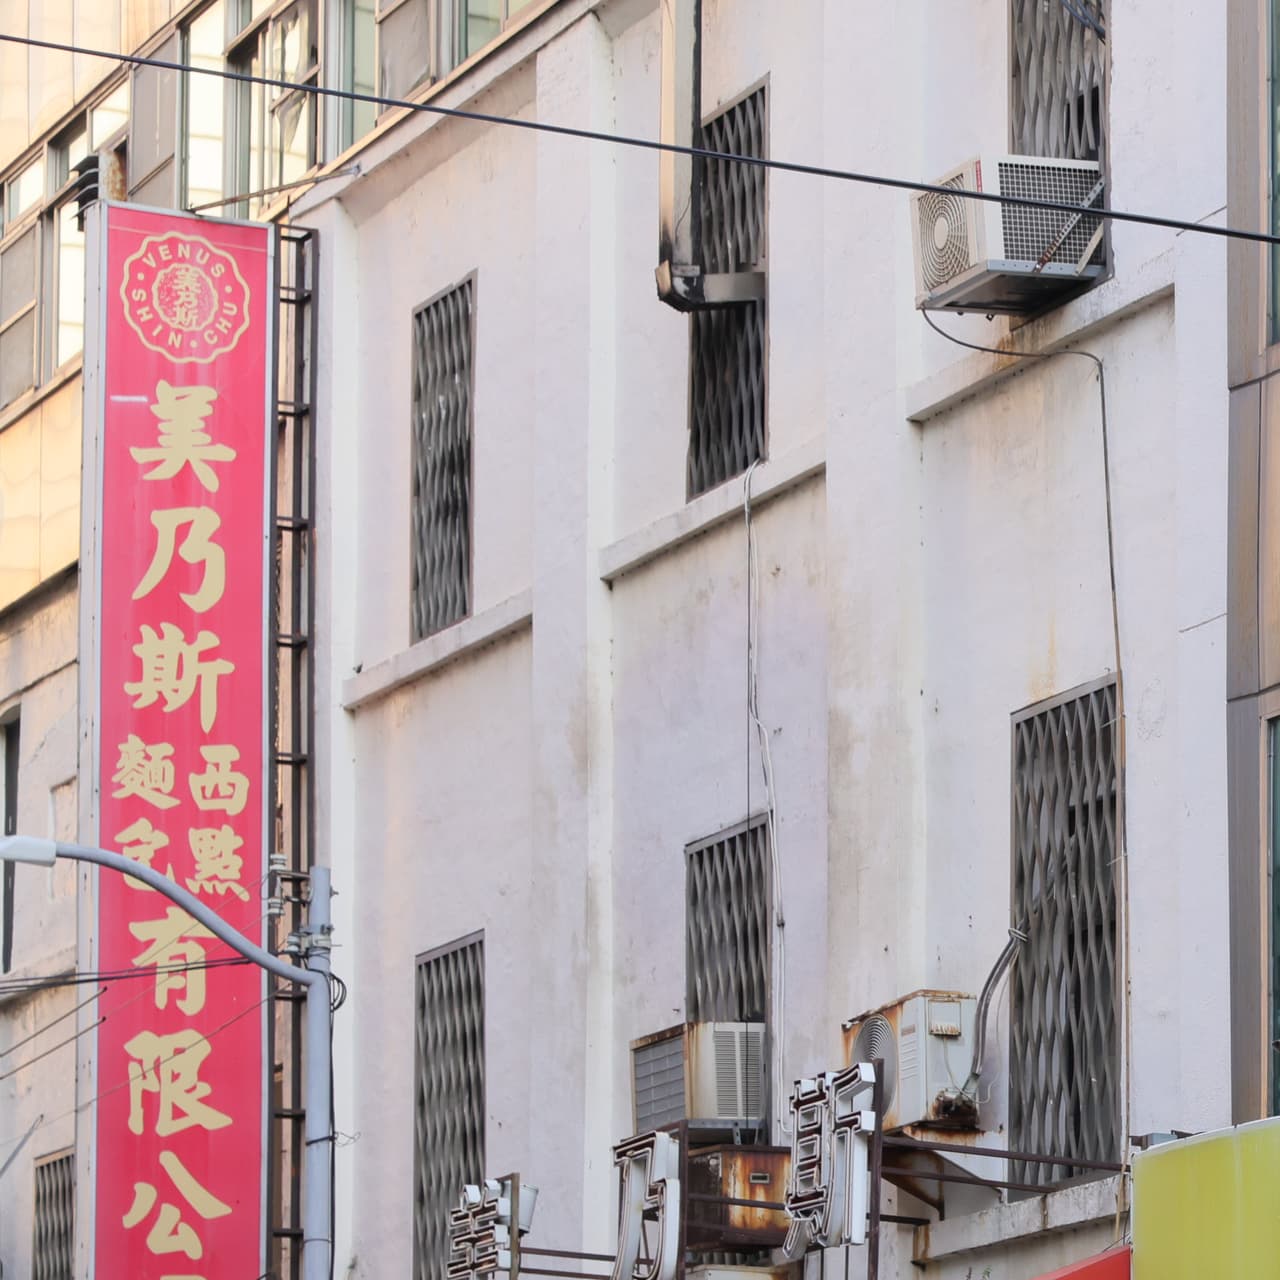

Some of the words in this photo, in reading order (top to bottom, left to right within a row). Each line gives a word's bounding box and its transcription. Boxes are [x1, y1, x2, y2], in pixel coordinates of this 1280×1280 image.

[142, 243, 226, 277] VENUS
[131, 289, 182, 348] SHIN
[203, 302, 239, 345] CHU
[123, 379, 238, 734] 美乃斯
[187, 743, 250, 903] 西點
